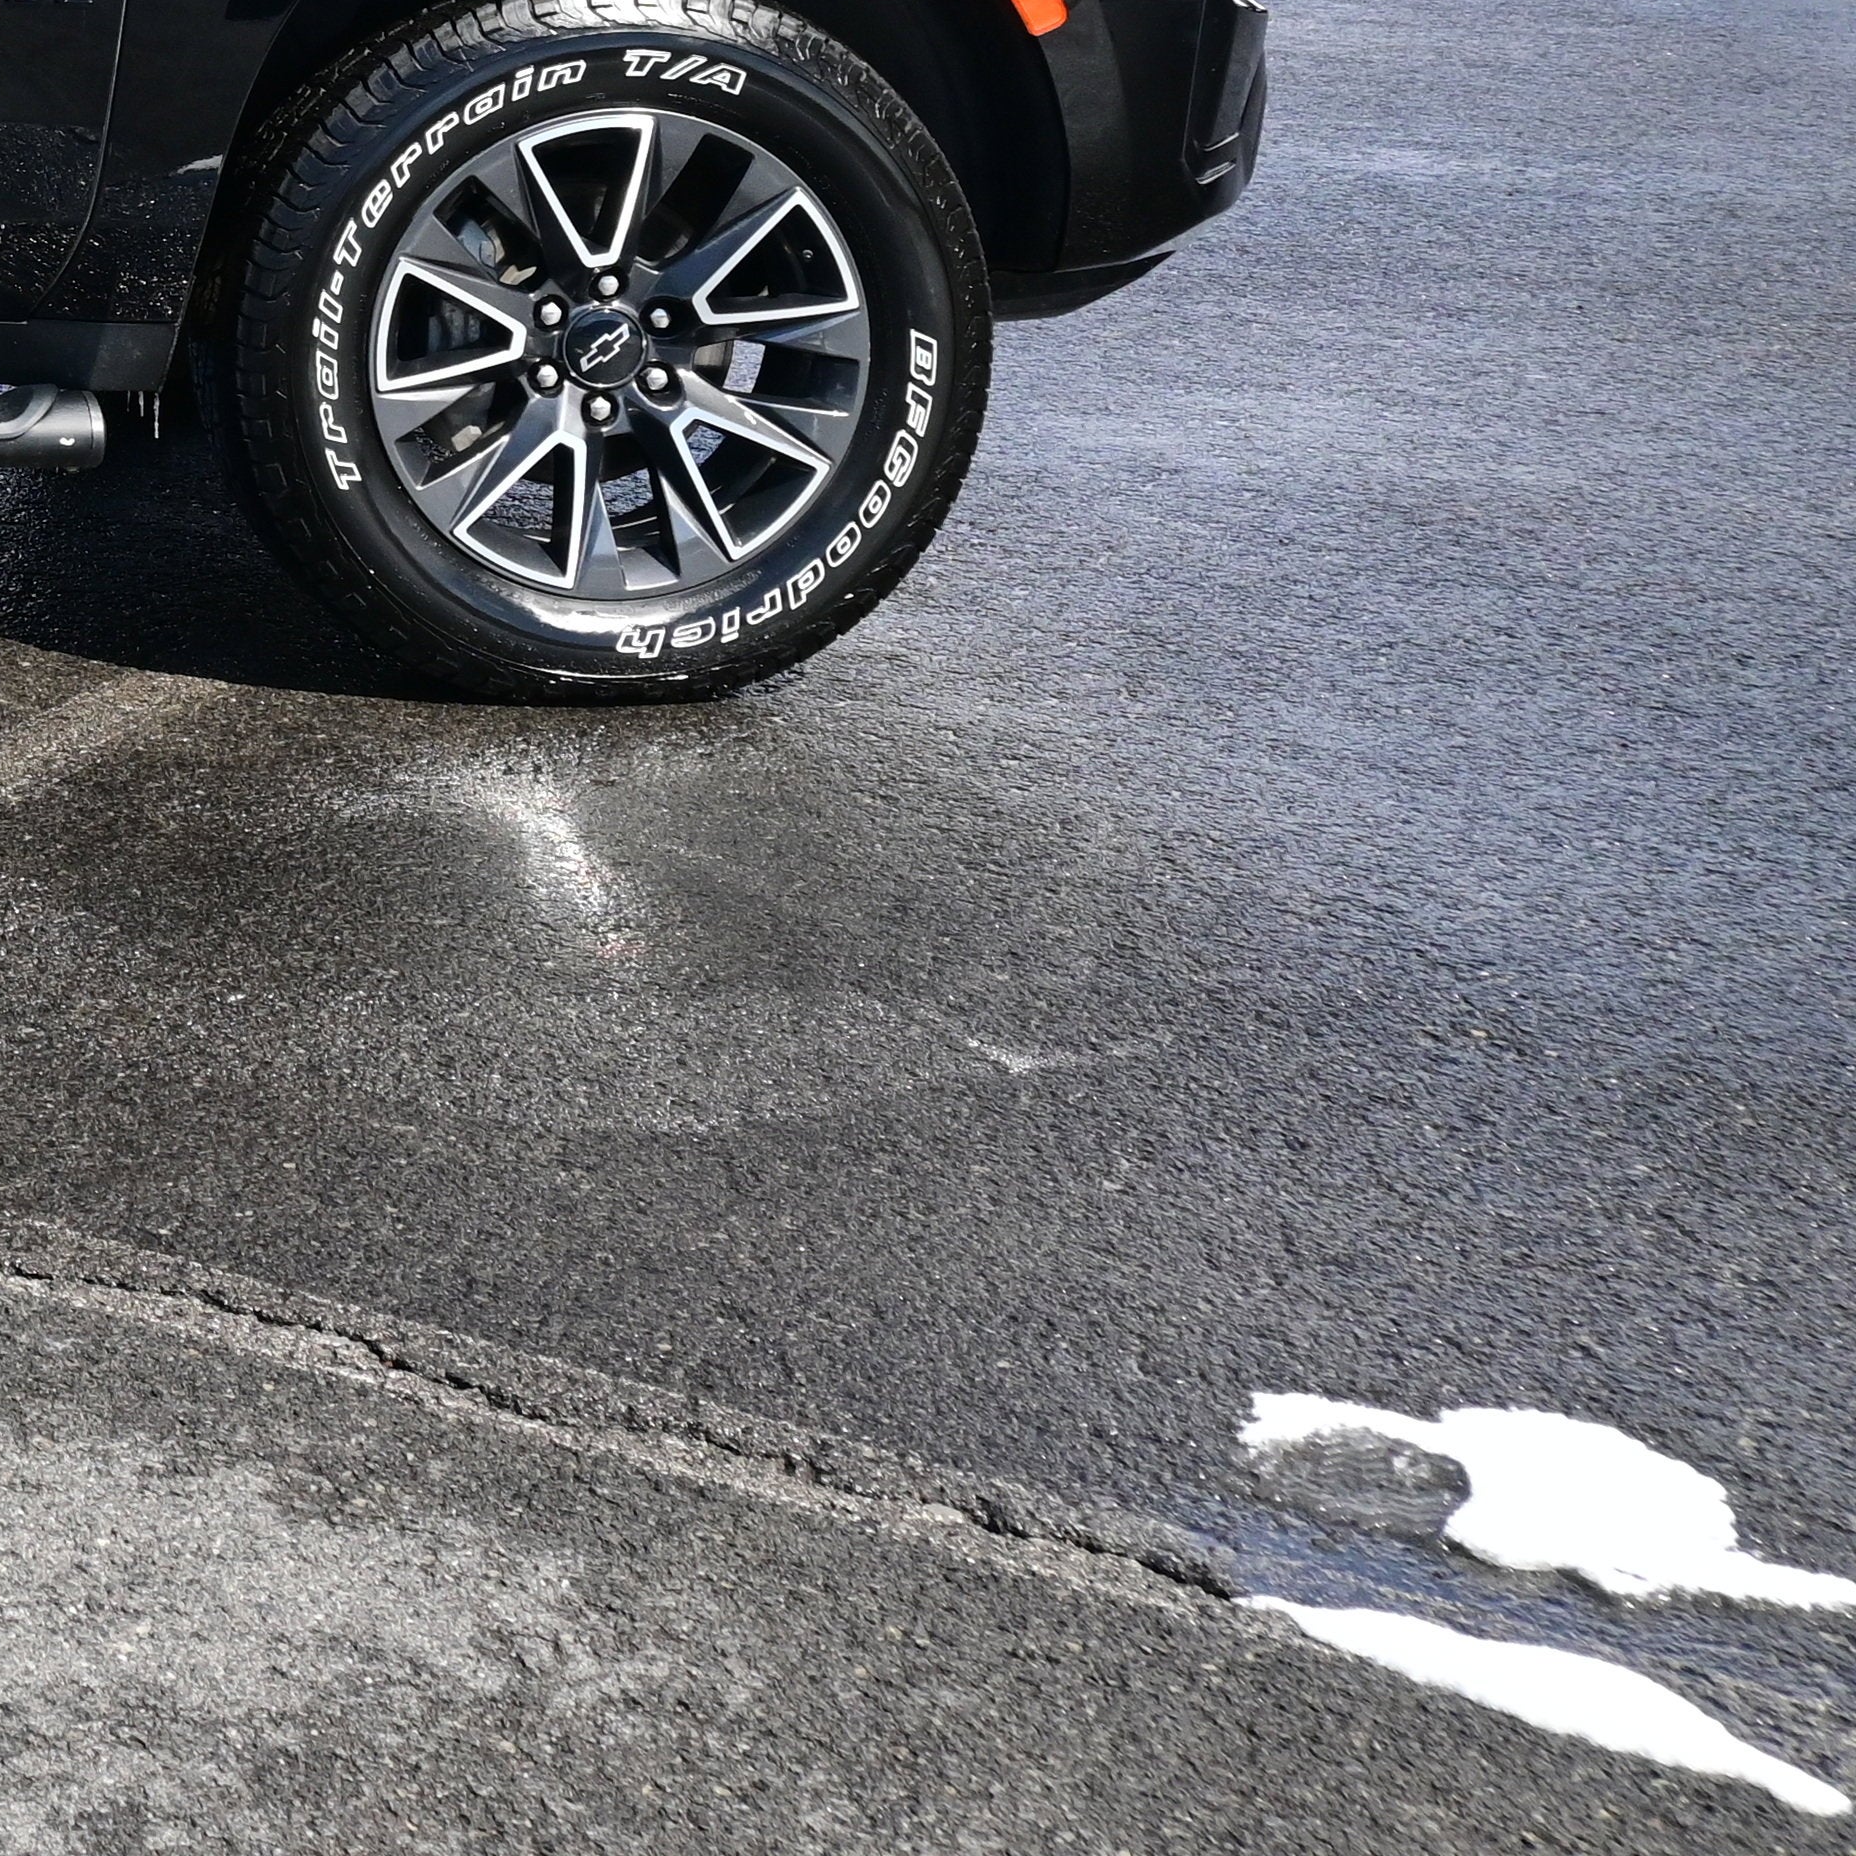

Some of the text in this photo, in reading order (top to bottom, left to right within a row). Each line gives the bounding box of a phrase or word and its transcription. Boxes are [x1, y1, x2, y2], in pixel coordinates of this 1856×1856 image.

[312, 50, 747, 491] Trail-Terrain T/A
[617, 328, 938, 658] BFGoodrich
